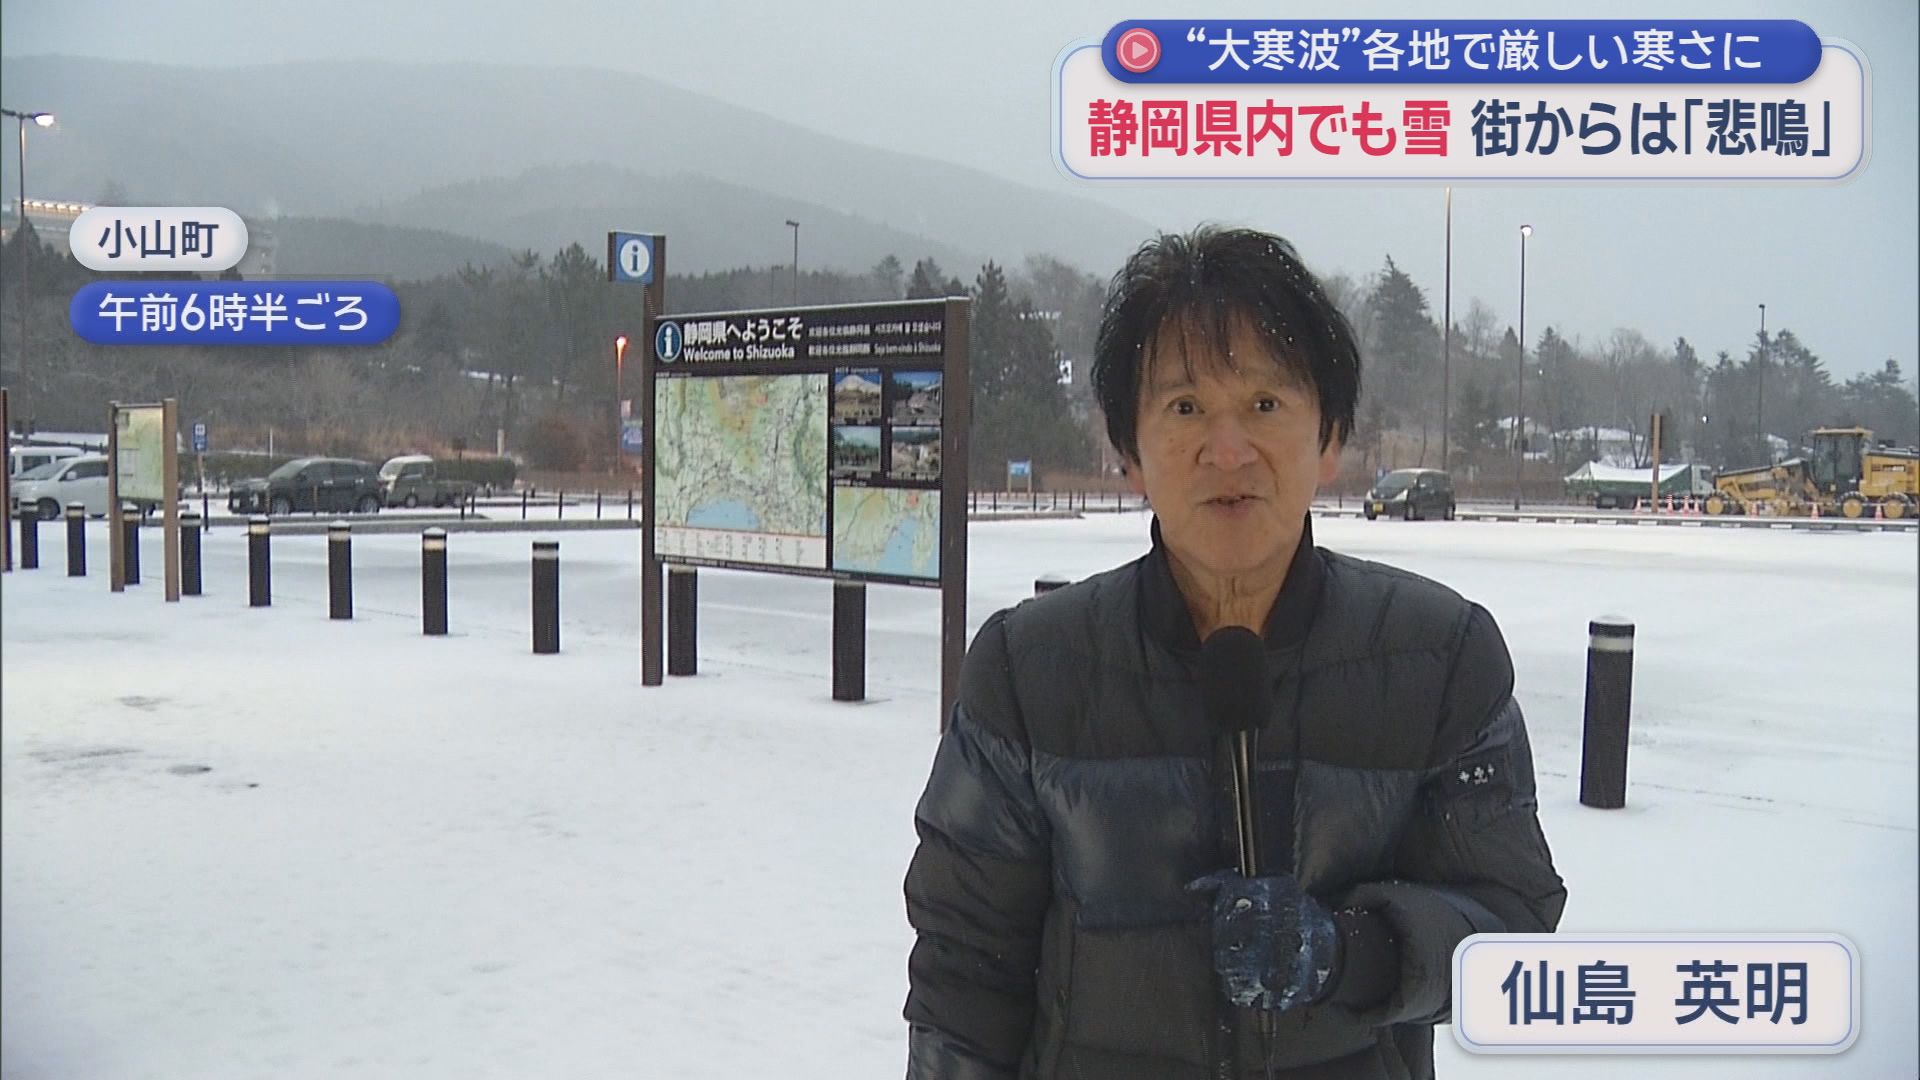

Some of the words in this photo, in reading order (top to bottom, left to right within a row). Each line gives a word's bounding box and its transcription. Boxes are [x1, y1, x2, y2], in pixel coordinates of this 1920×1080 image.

[683, 317, 803, 346] 静岡県へようこそ
[684, 346, 731, 362] Welcome
[733, 346, 744, 360] to
[746, 343, 796, 359] Shizuoka
